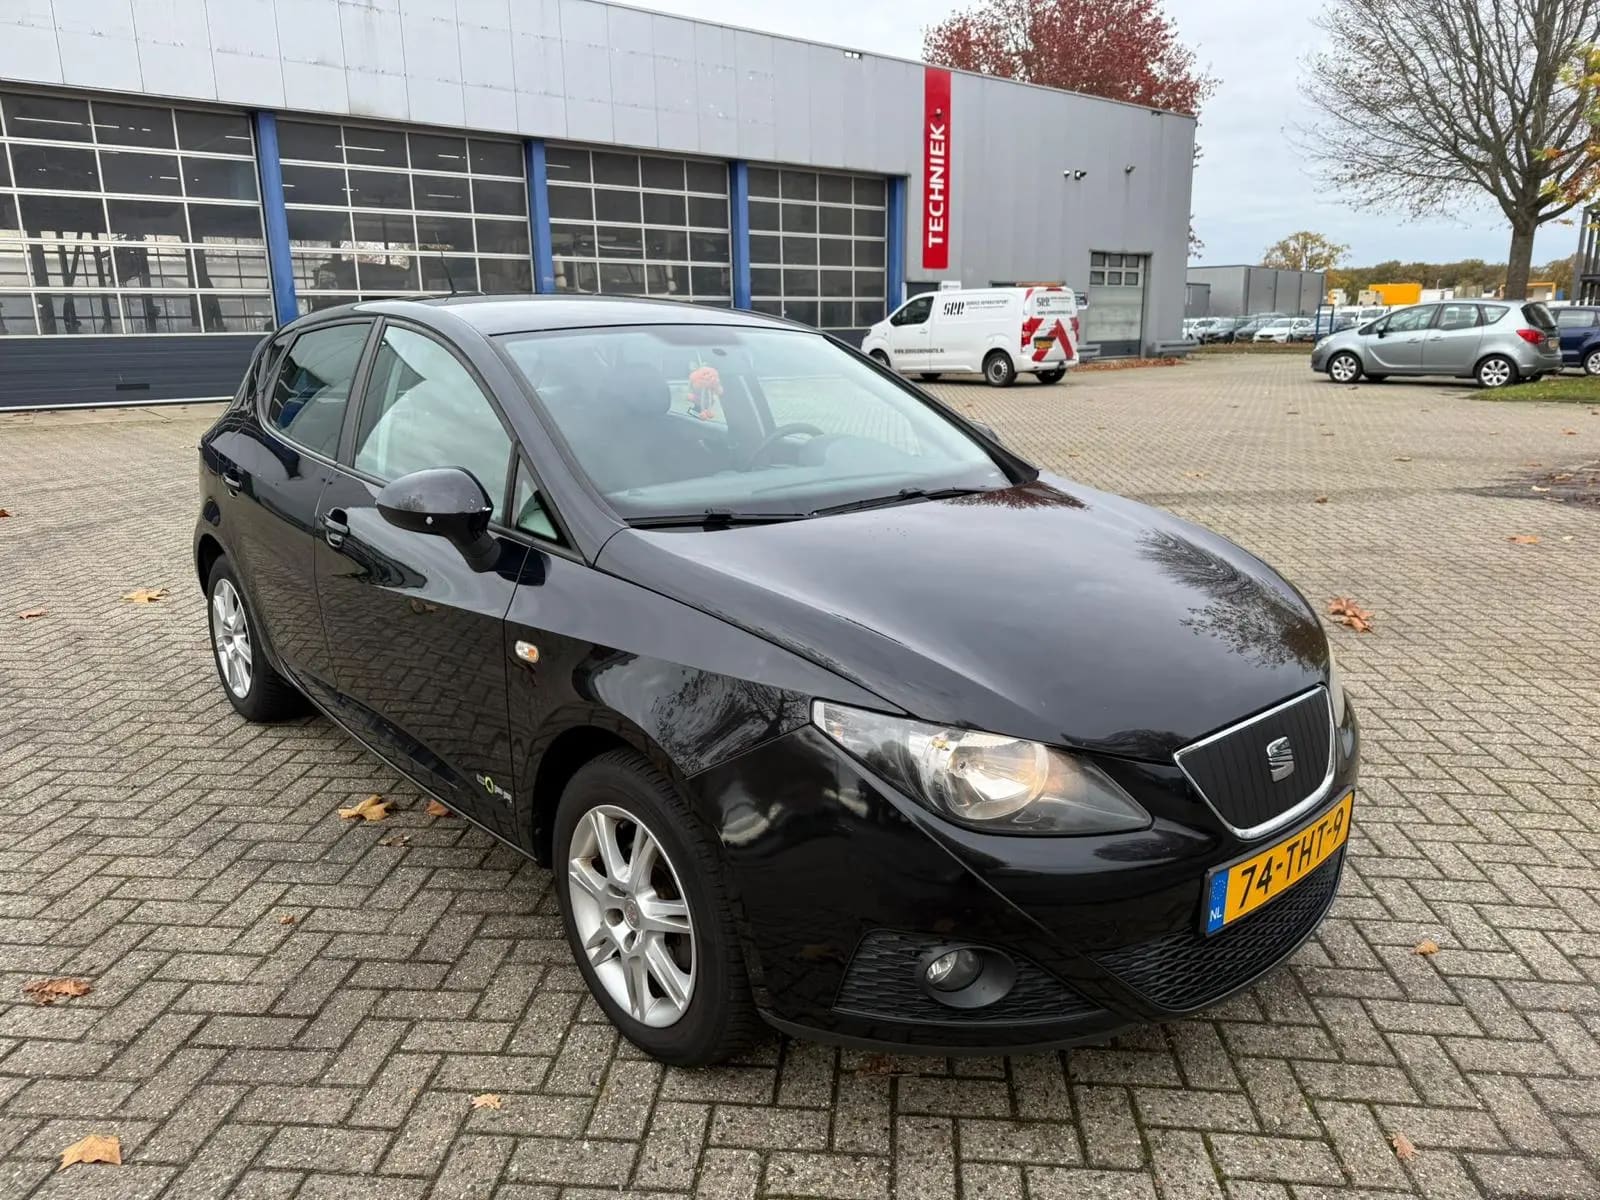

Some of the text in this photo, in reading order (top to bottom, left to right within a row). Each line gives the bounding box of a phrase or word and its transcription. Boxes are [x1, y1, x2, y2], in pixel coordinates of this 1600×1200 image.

[928, 123, 945, 248] TECHNIEK
[1239, 807, 1344, 909] 74-THT-9
[1209, 907, 1222, 922] NL
